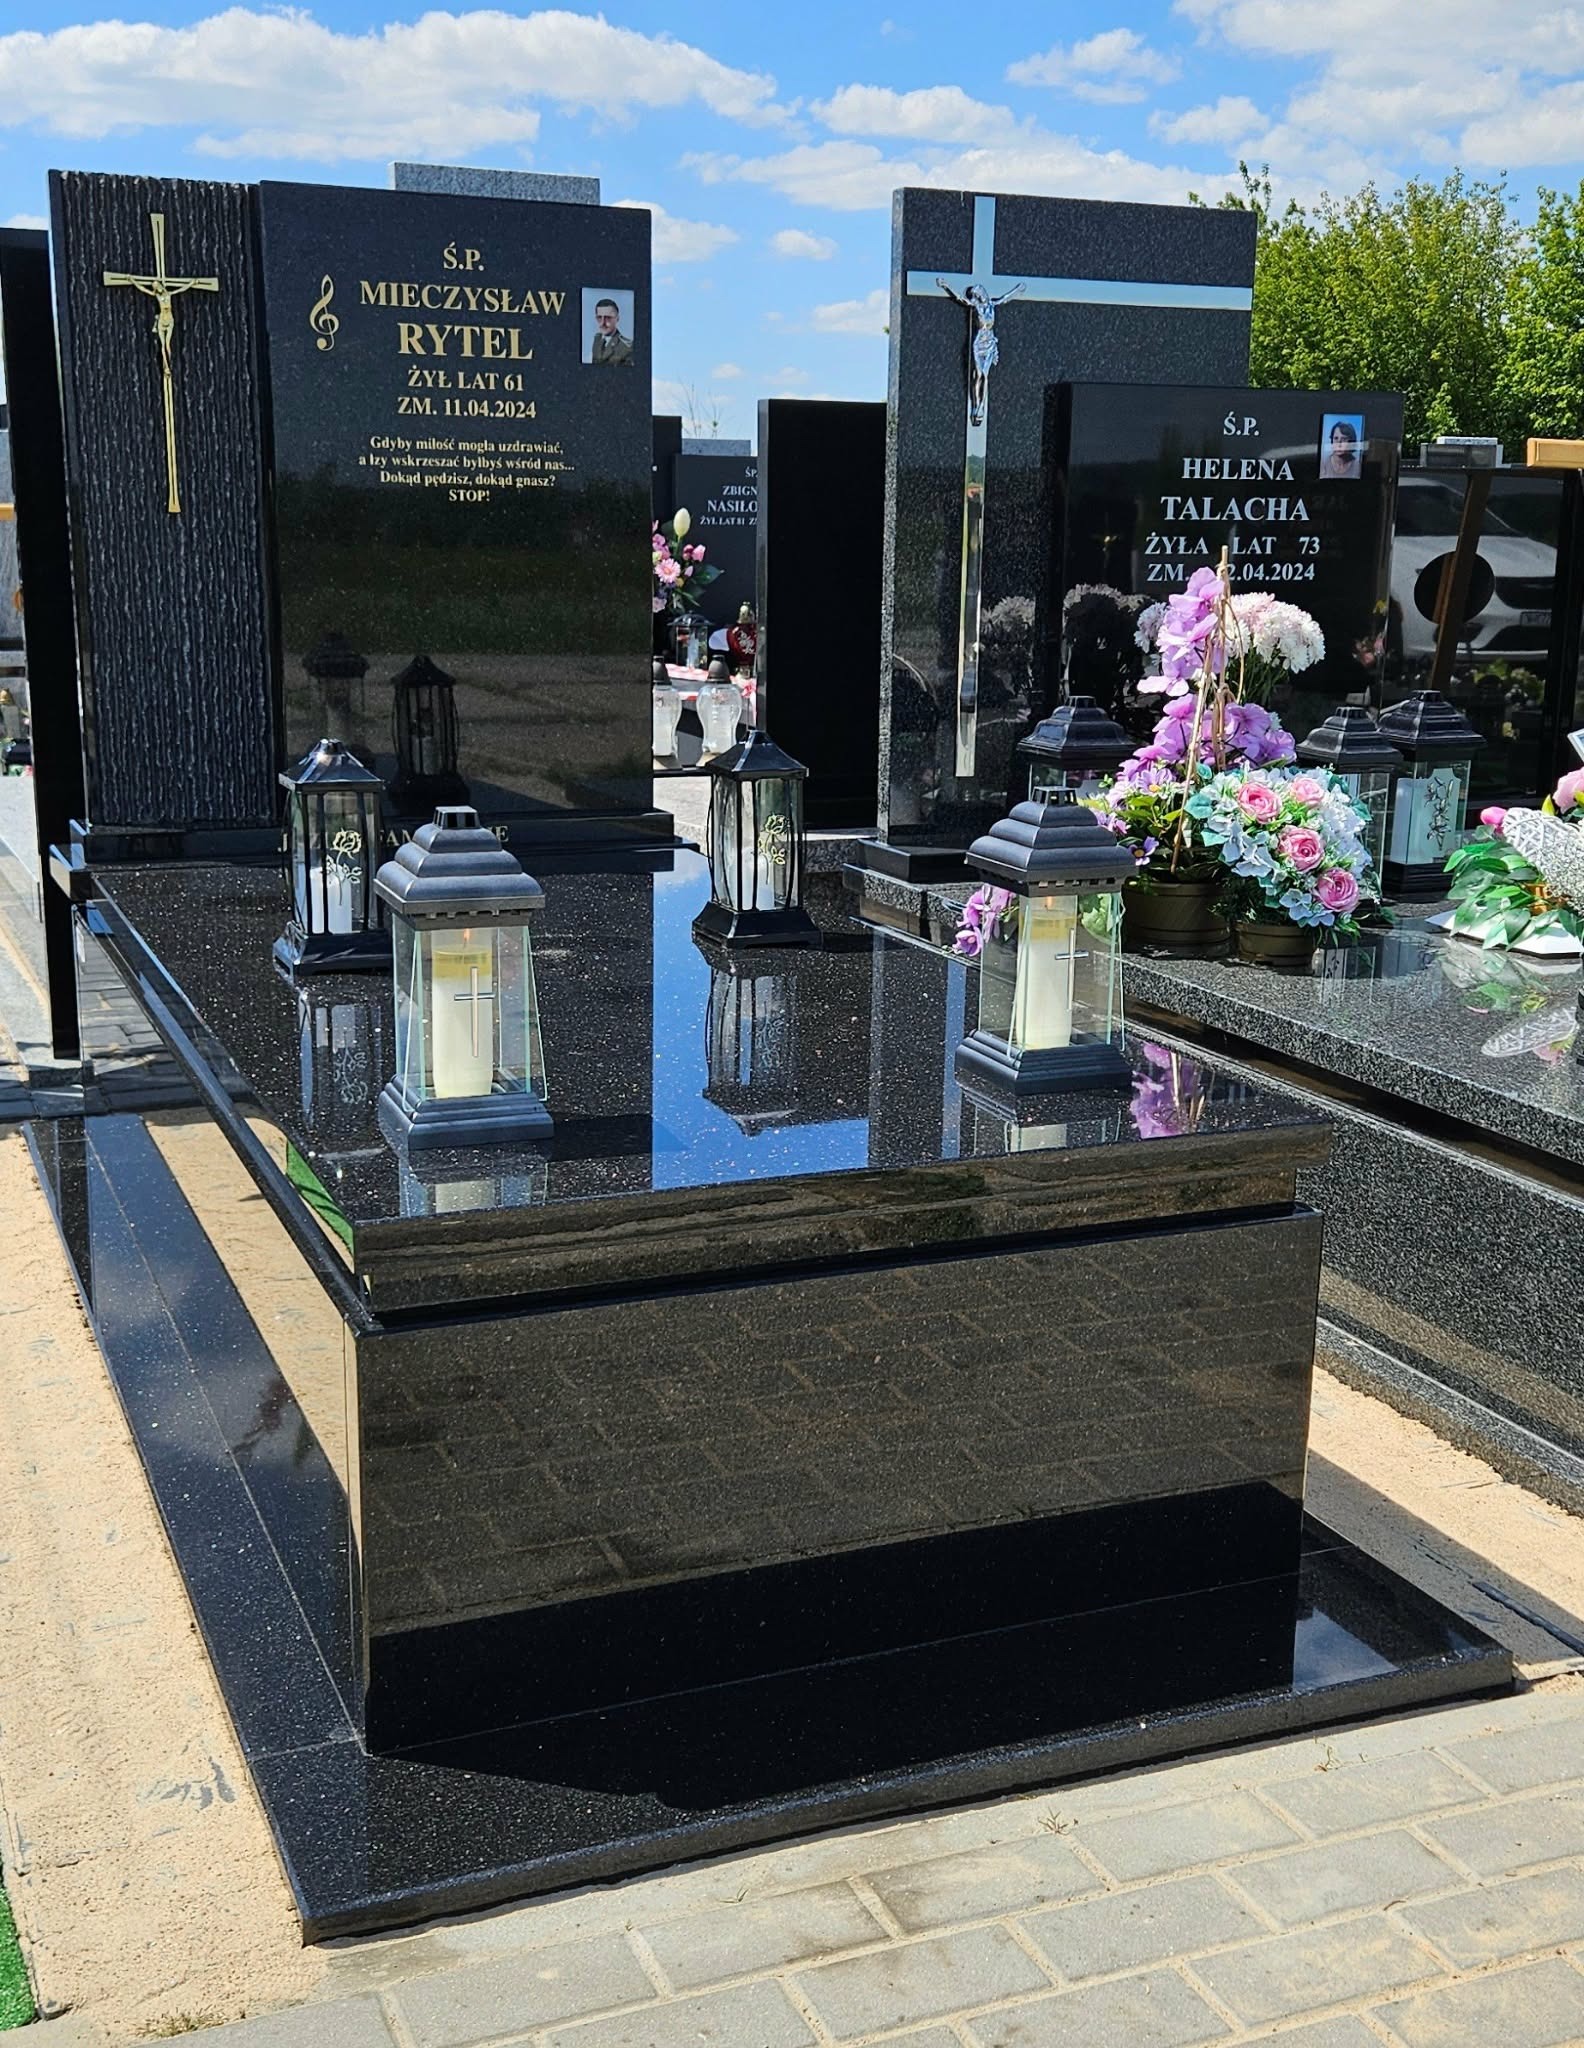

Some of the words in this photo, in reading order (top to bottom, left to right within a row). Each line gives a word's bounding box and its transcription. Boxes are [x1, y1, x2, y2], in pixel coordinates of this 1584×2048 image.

[444, 242, 484, 271] Ś.P.
[360, 281, 565, 315] MIECZYSŁAW
[398, 323, 532, 359] RYTEL
[408, 365, 451, 387] ŻYŁ
[458, 372, 499, 389] LAT
[505, 375, 523, 391] 61
[398, 397, 437, 415] ZM.
[445, 399, 536, 418] 11.04.2024
[1224, 412, 1259, 435] Ś.P.
[371, 437, 411, 451] Gdyby
[499, 441, 564, 455] uzdrawiać,
[391, 453, 460, 468] wskrzeszać
[506, 458, 540, 469] wśród
[1182, 457, 1295, 481] HELENA
[381, 471, 420, 486] Dokąd
[425, 472, 472, 487] pędzisz,
[476, 473, 512, 488] dokąd
[516, 475, 555, 488] gnasz?
[450, 490, 489, 501] STOP!
[1161, 497, 1309, 520] TALACHA
[1145, 532, 1208, 554] ŻYŁA
[1232, 537, 1276, 554] LAT
[1299, 537, 1319, 554] 73
[1147, 563, 1190, 582] ZM.
[1214, 562, 1316, 582] 2.04.2024
